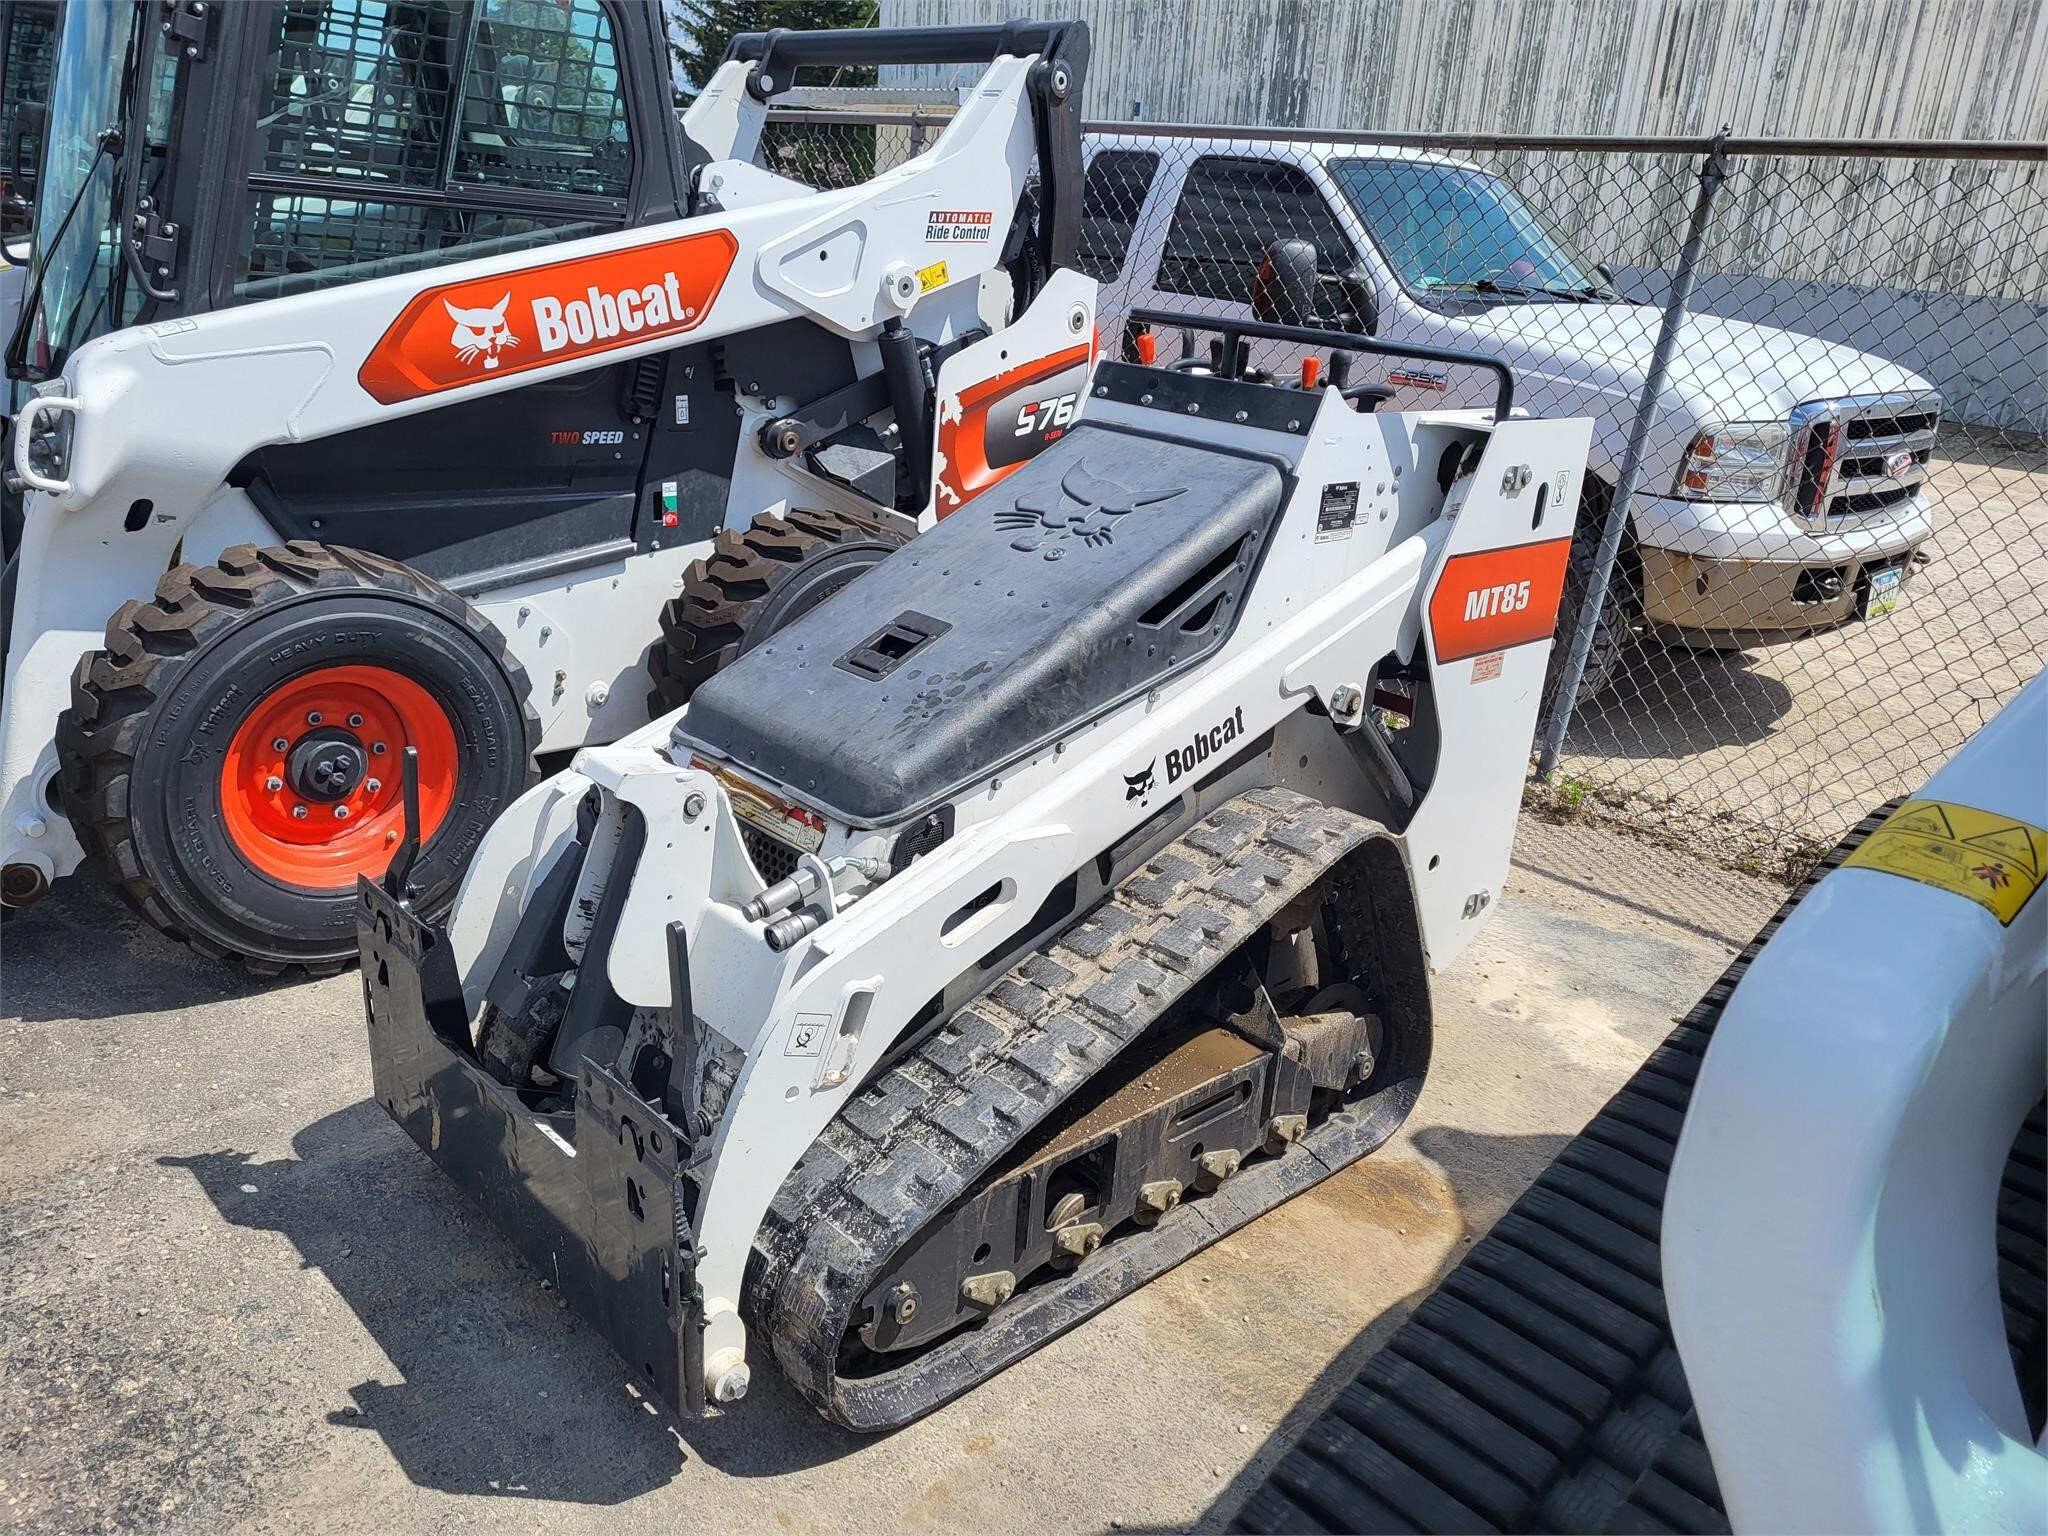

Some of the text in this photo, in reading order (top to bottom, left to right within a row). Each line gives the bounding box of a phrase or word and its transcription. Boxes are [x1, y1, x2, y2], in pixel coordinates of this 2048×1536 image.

[925, 225, 991, 240] Ride Control
[930, 212, 991, 223] AUTOMATIC
[531, 271, 686, 352] Bobcat
[1014, 392, 1077, 437] S76
[551, 431, 624, 445] TWO SPEED
[1463, 580, 1531, 622] MT85
[269, 634, 328, 667] HEAVY
[334, 630, 383, 644] DUTY
[460, 676, 487, 715] BEAD
[1165, 705, 1245, 785] Bobcat
